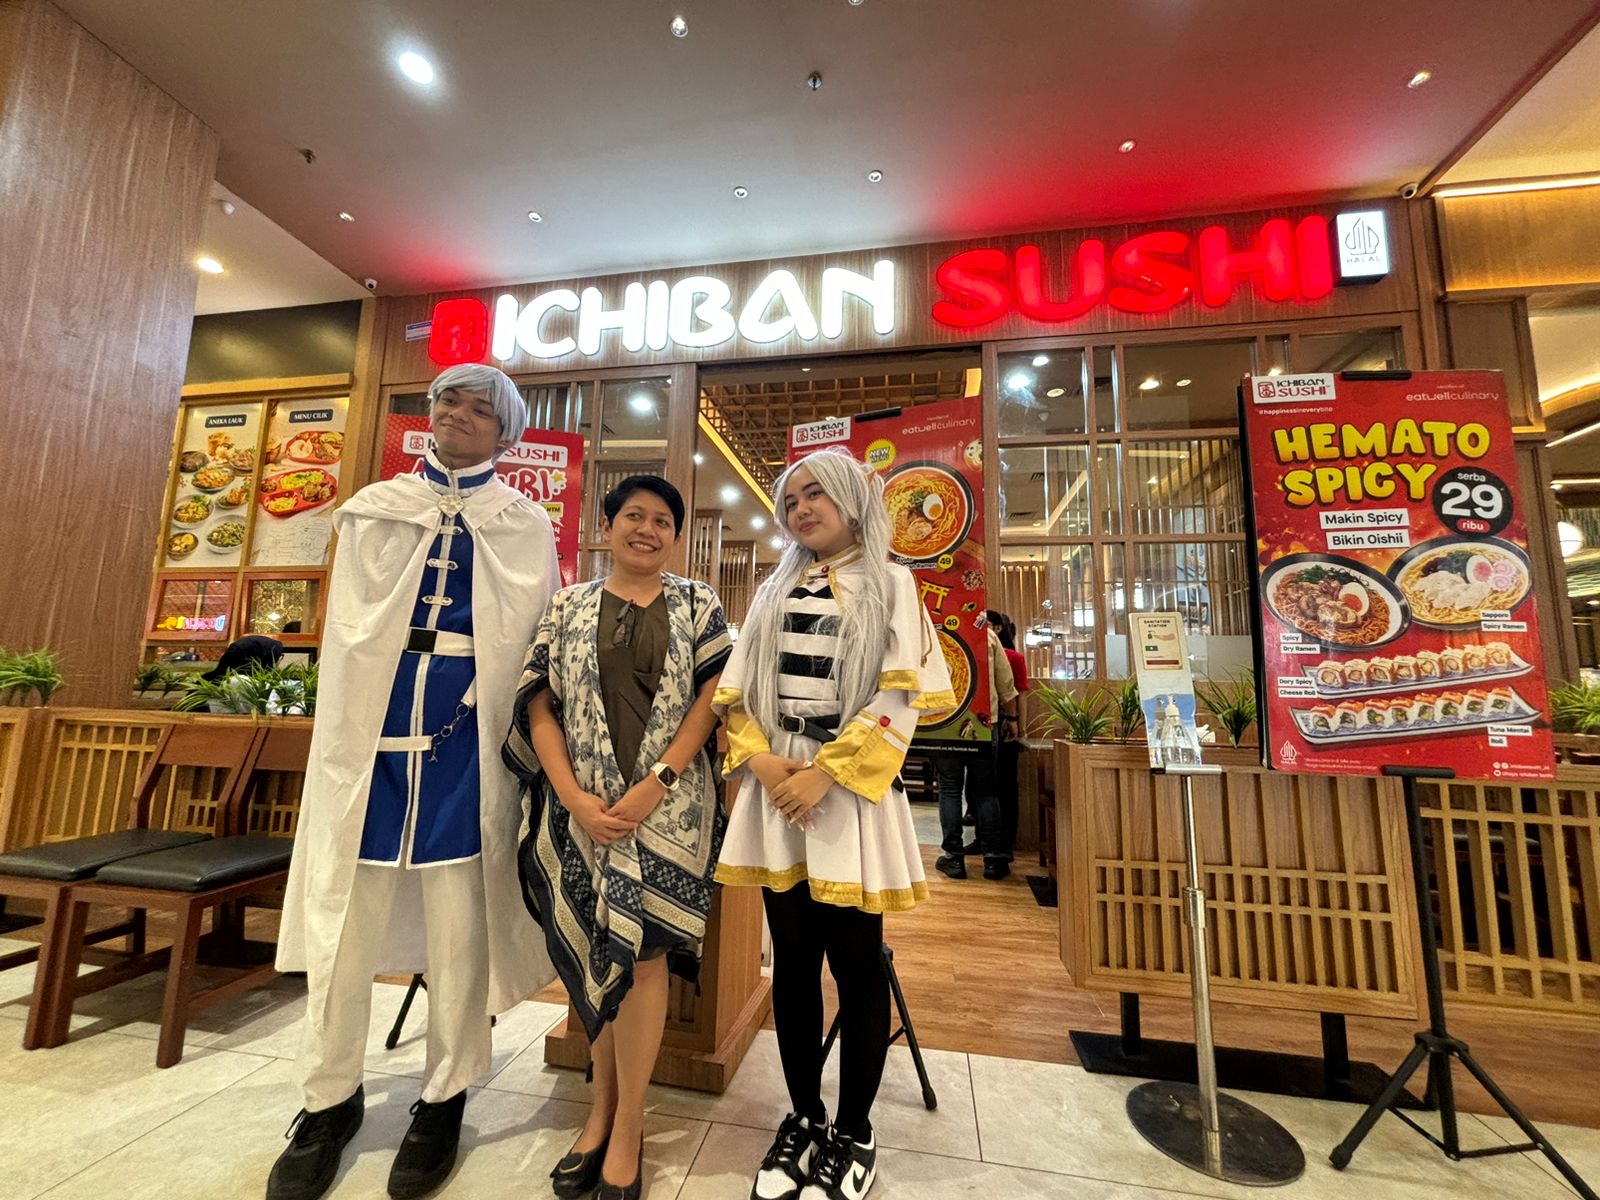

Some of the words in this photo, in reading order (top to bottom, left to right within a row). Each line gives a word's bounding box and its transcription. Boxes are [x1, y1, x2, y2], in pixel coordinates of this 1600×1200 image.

[491, 258, 896, 362] ICHIBAN
[931, 214, 1334, 329] SUSHI
[1277, 378, 1325, 388] ICHIBAN
[1278, 386, 1327, 398] SUSHI
[809, 421, 844, 432] ICHIBAN
[809, 429, 845, 441] SUSHI
[1273, 418, 1491, 464] HEMATO
[504, 447, 560, 463] SUSHI
[869, 447, 890, 458] NEW
[1282, 460, 1438, 506] SPICY
[1457, 472, 1486, 482] serba
[1440, 481, 1503, 519] 29
[1325, 512, 1364, 524] Makin
[1367, 511, 1403, 525] Spicy
[1462, 520, 1484, 530] ribu
[1332, 534, 1364, 545] Bikin
[1367, 532, 1404, 544] Oishii
[939, 557, 952, 565] 49
[945, 618, 958, 626] 49
